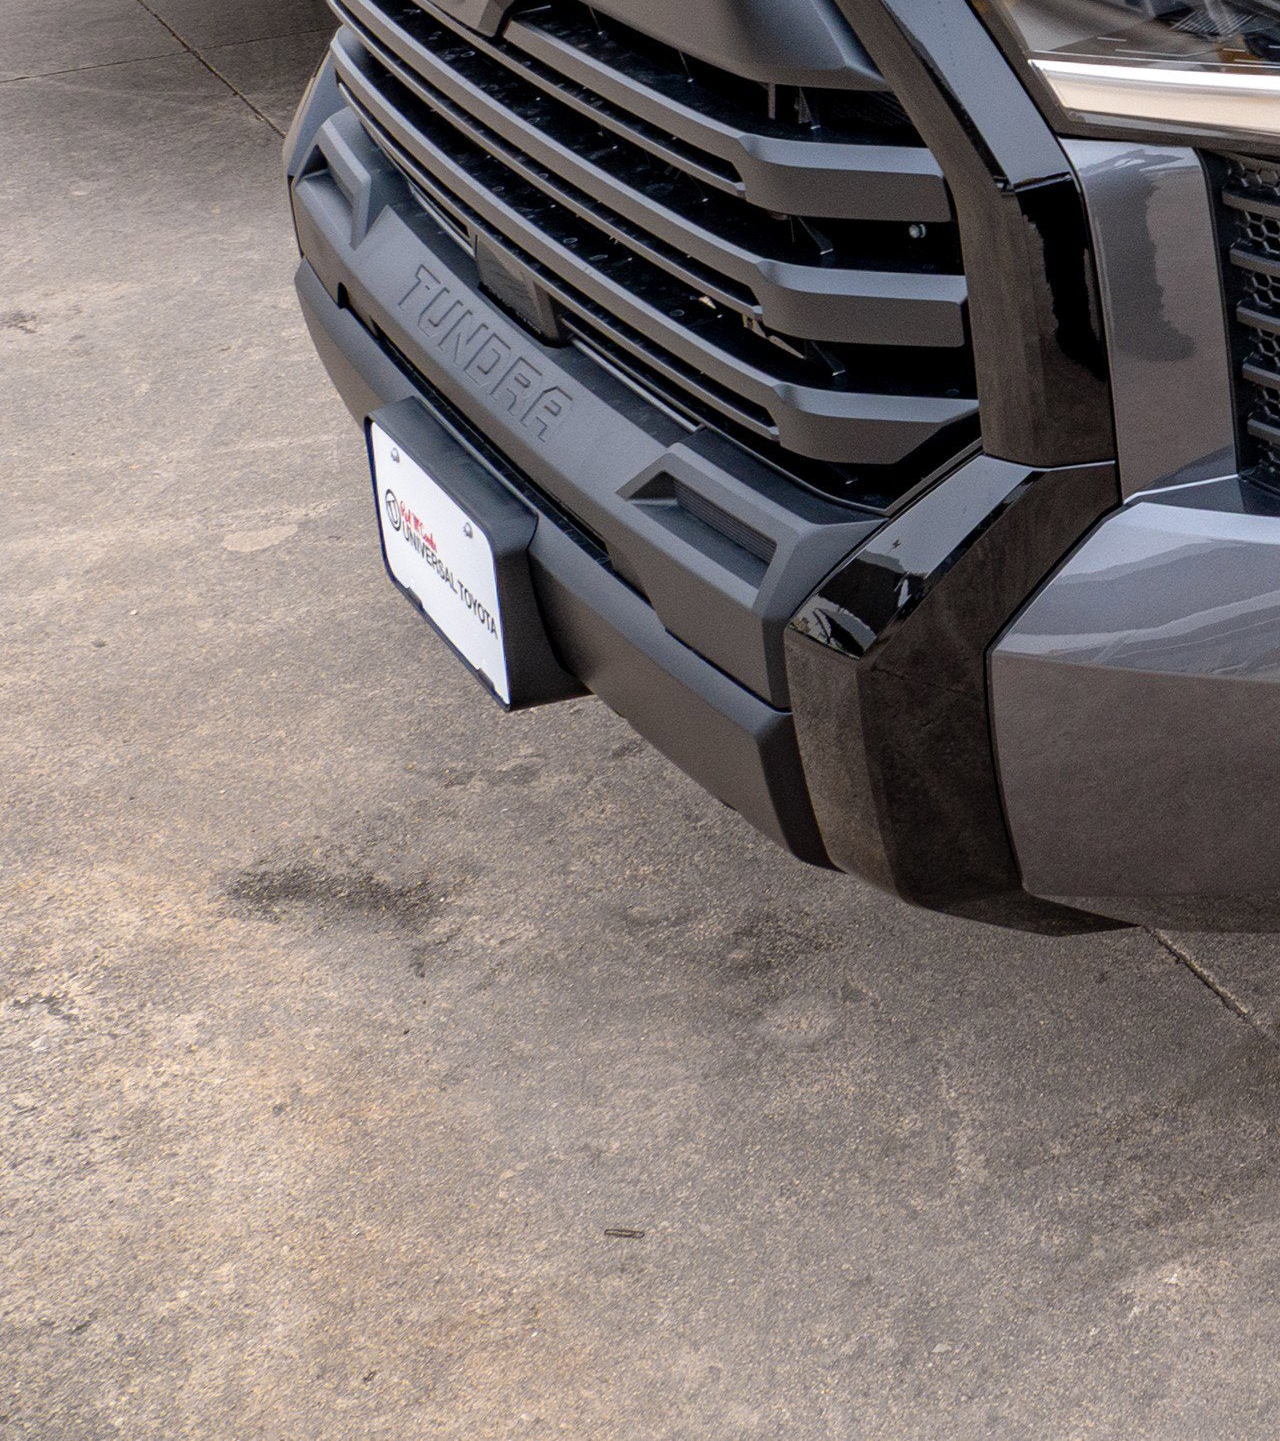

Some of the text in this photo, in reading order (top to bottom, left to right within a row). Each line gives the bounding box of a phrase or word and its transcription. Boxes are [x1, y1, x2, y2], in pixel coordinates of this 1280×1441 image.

[397, 263, 574, 444] TUNDRA
[402, 521, 499, 640] UNIVERSAL TOYOTA
